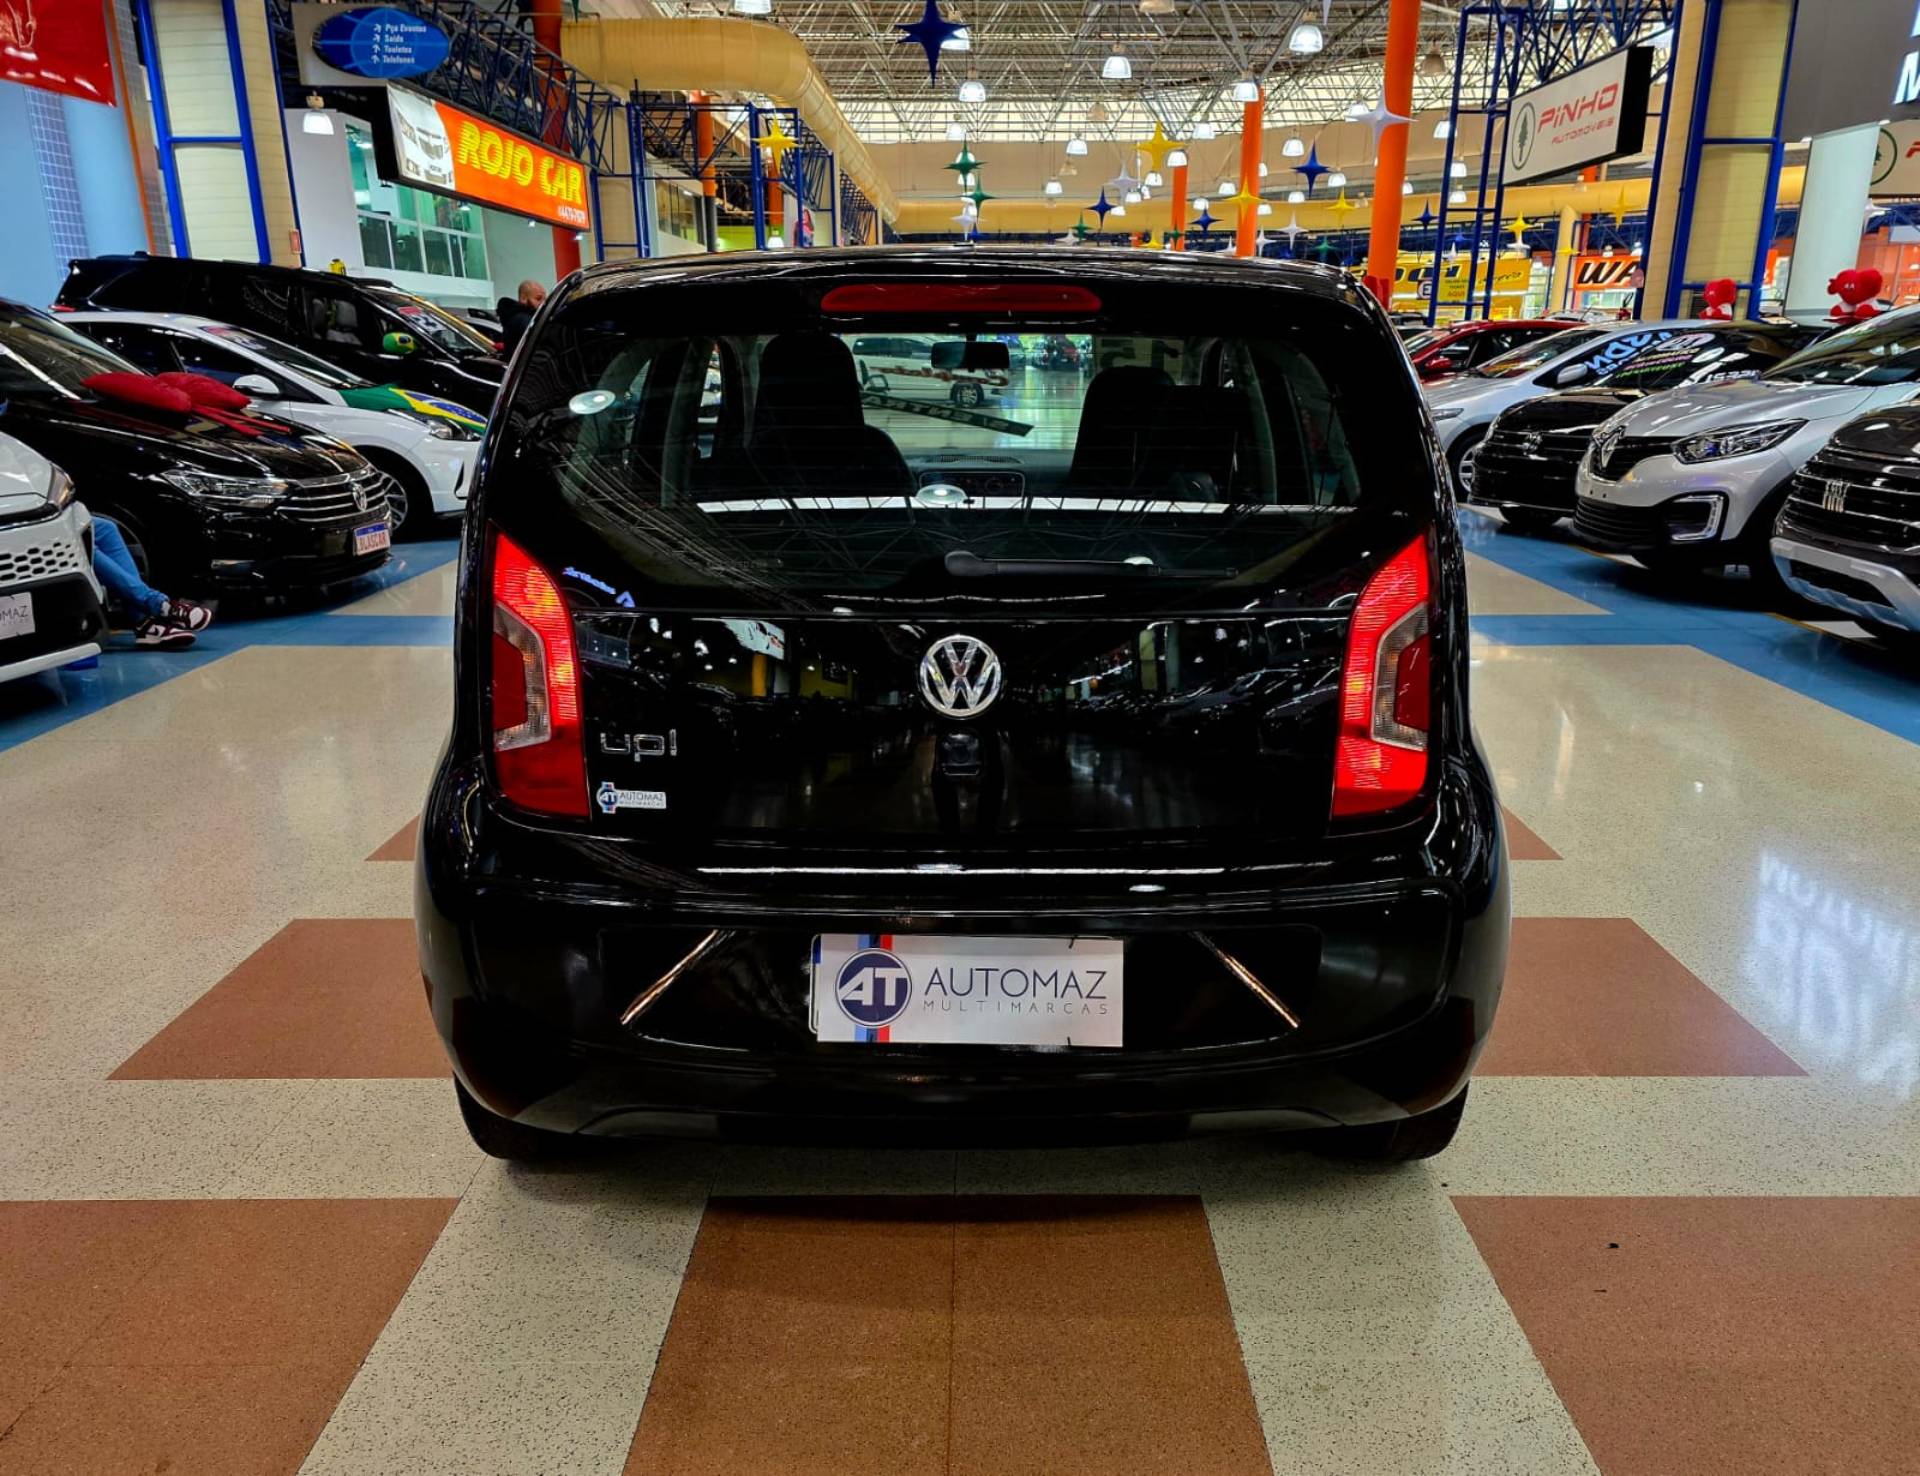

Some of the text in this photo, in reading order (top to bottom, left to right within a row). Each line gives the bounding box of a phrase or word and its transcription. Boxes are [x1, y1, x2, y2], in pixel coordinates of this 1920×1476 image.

[1537, 82, 1619, 133] PINHO
[458, 121, 582, 205] ROJO CAR
[600, 729, 677, 762] up!
[620, 791, 664, 801] AUTOMAZ
[924, 967, 1107, 1000] AUTOMAZ
[923, 1000, 1109, 1015] MULTIMARCAS
